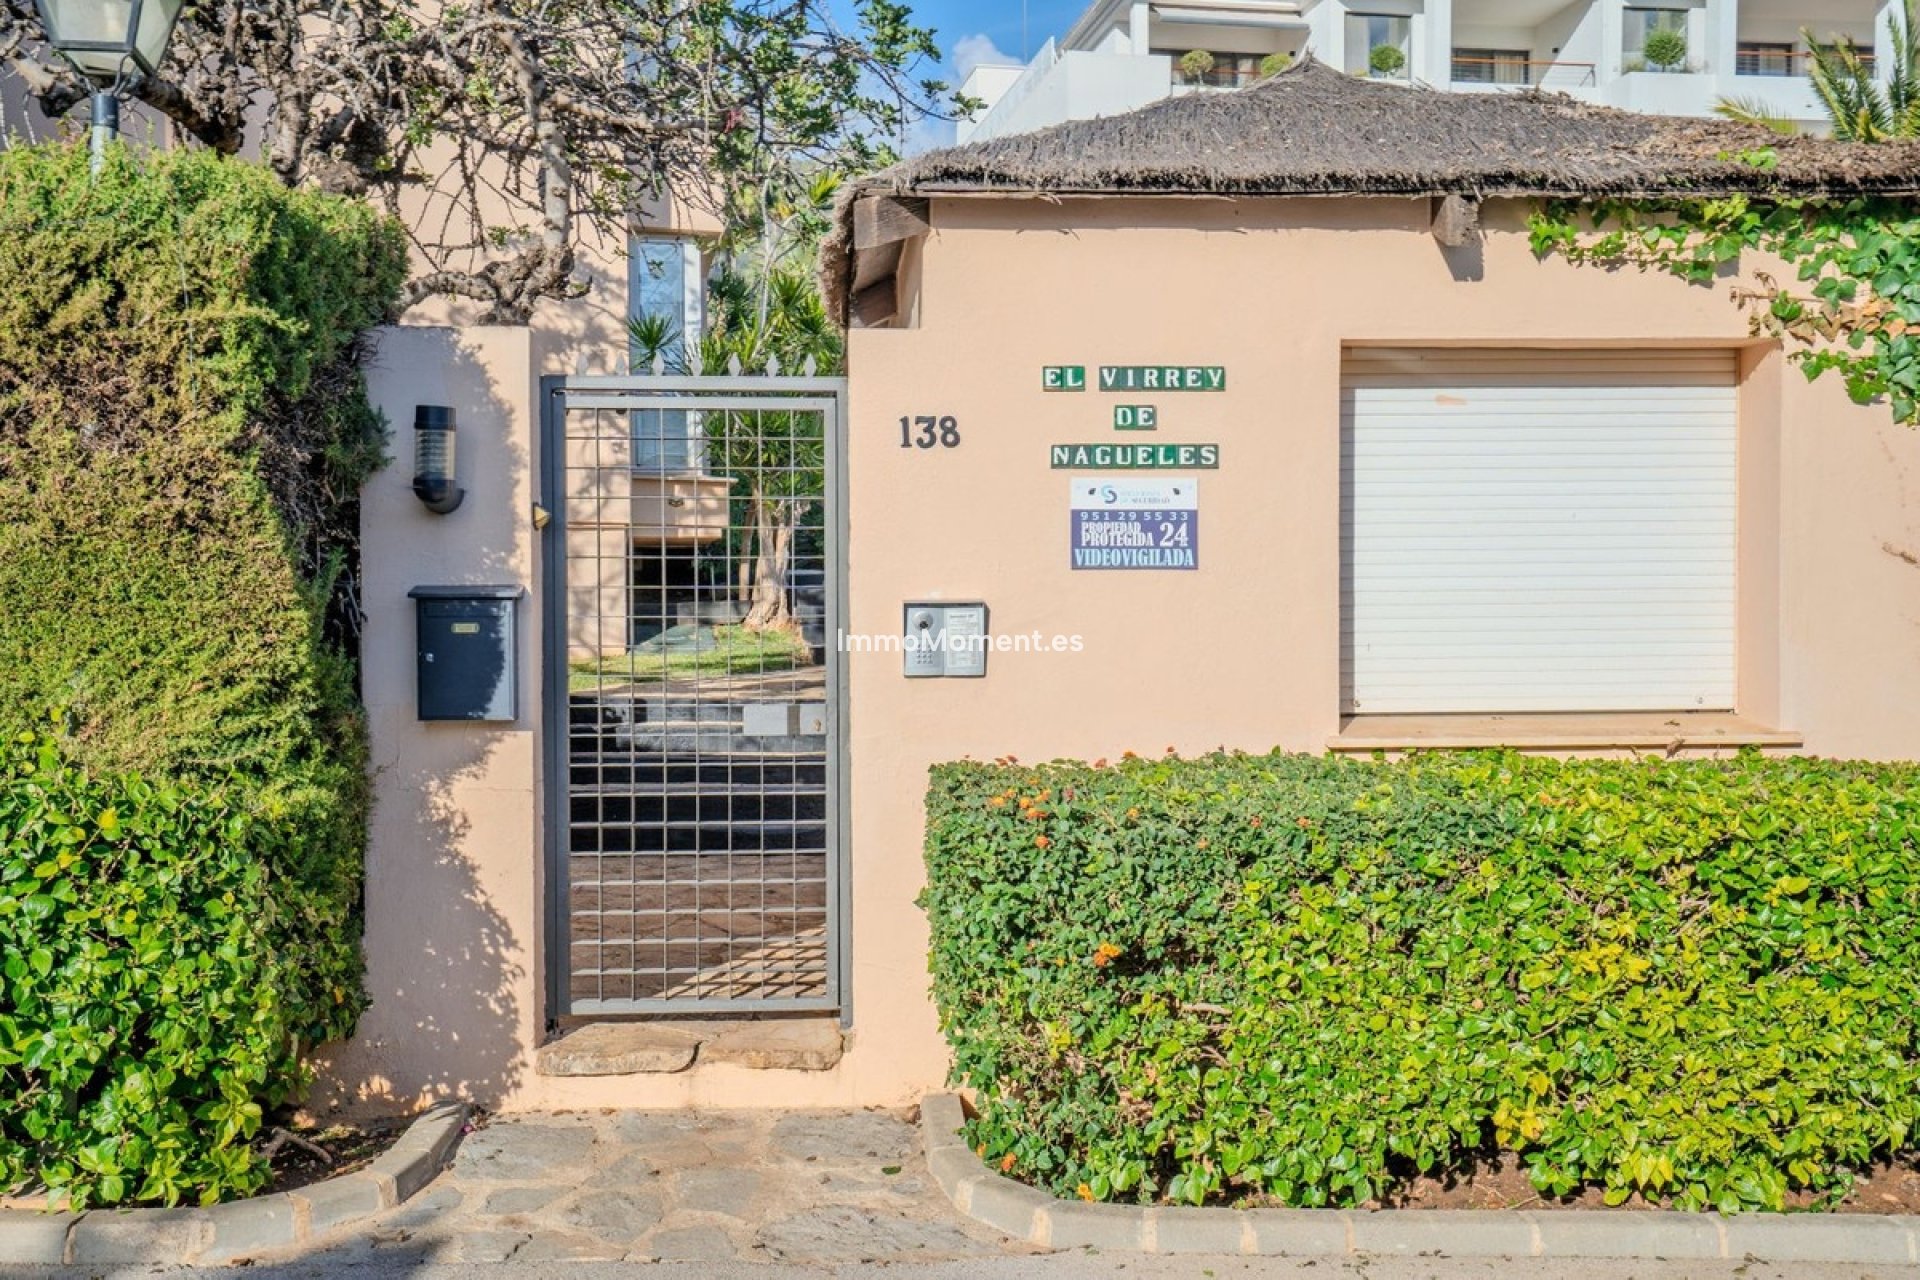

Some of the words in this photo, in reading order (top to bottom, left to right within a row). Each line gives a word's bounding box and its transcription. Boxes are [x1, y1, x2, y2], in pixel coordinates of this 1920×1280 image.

[1045, 368, 1082, 387] EL
[1102, 368, 1222, 387] VIRREY
[1116, 407, 1153, 426] DE
[899, 416, 960, 449] 138
[1053, 446, 1216, 465] NAGUELES
[1081, 521, 1141, 533] PROPIEDAD
[1159, 522, 1189, 547] 24
[1081, 532, 1154, 546] PROTEGIDA
[1074, 548, 1194, 566] VIDEOVIGILADA
